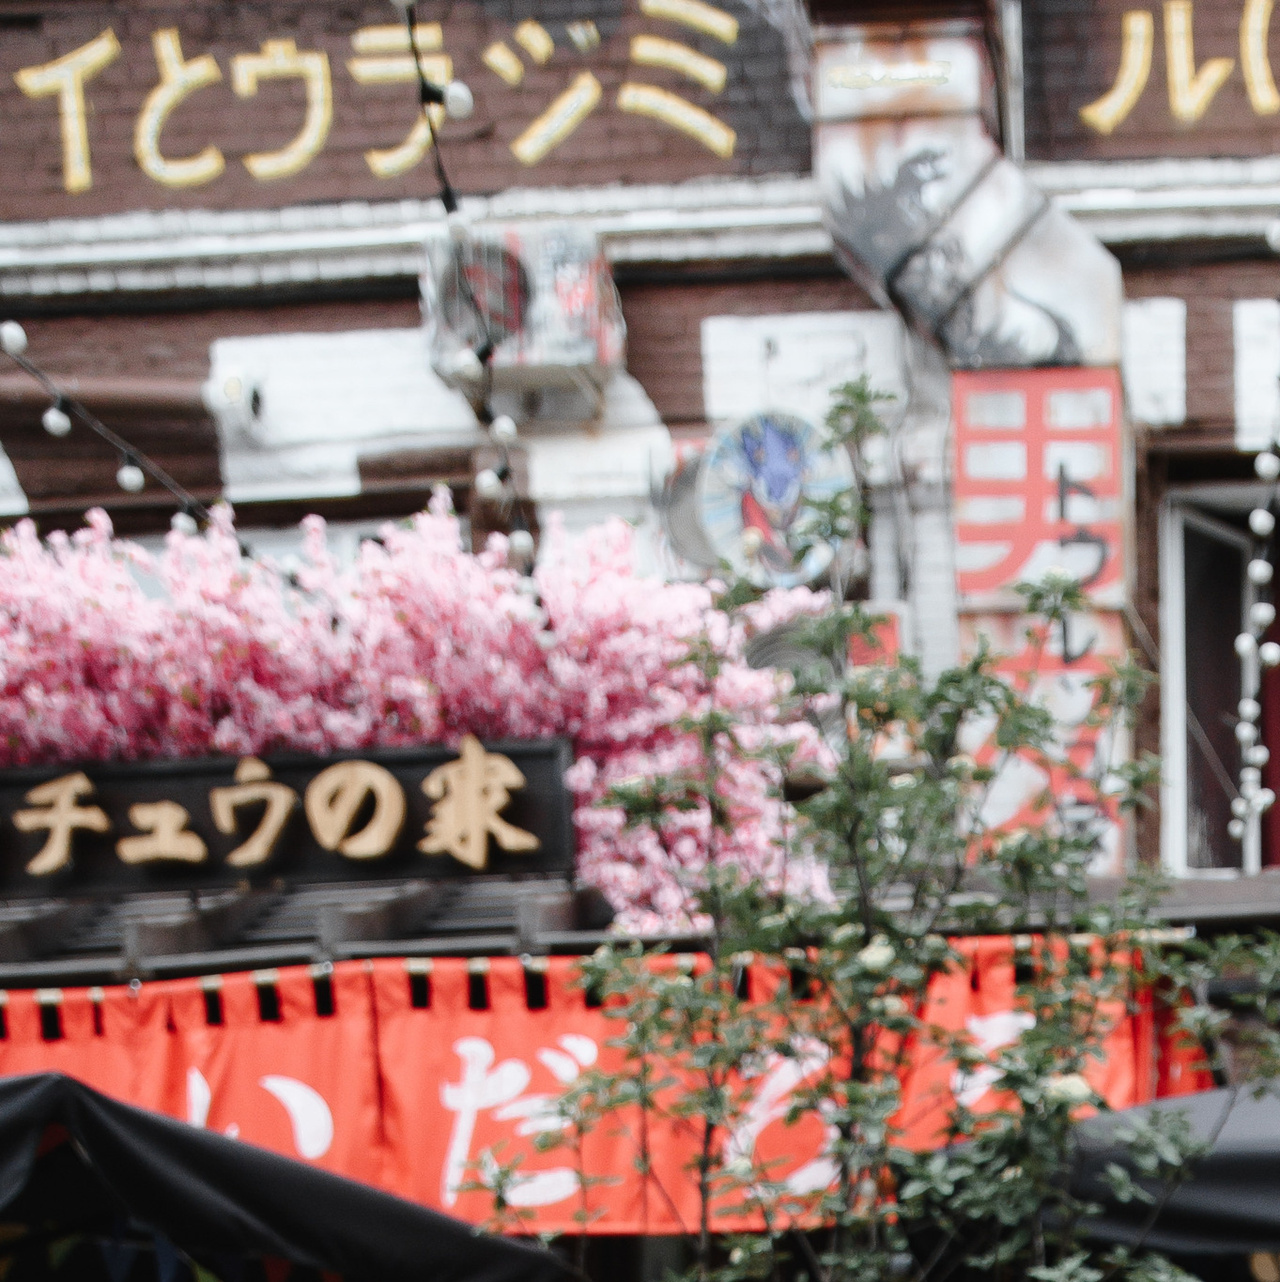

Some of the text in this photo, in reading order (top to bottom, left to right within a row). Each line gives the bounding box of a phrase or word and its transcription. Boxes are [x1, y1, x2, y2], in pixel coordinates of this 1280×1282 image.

[12, 733, 541, 876] チュウの家
